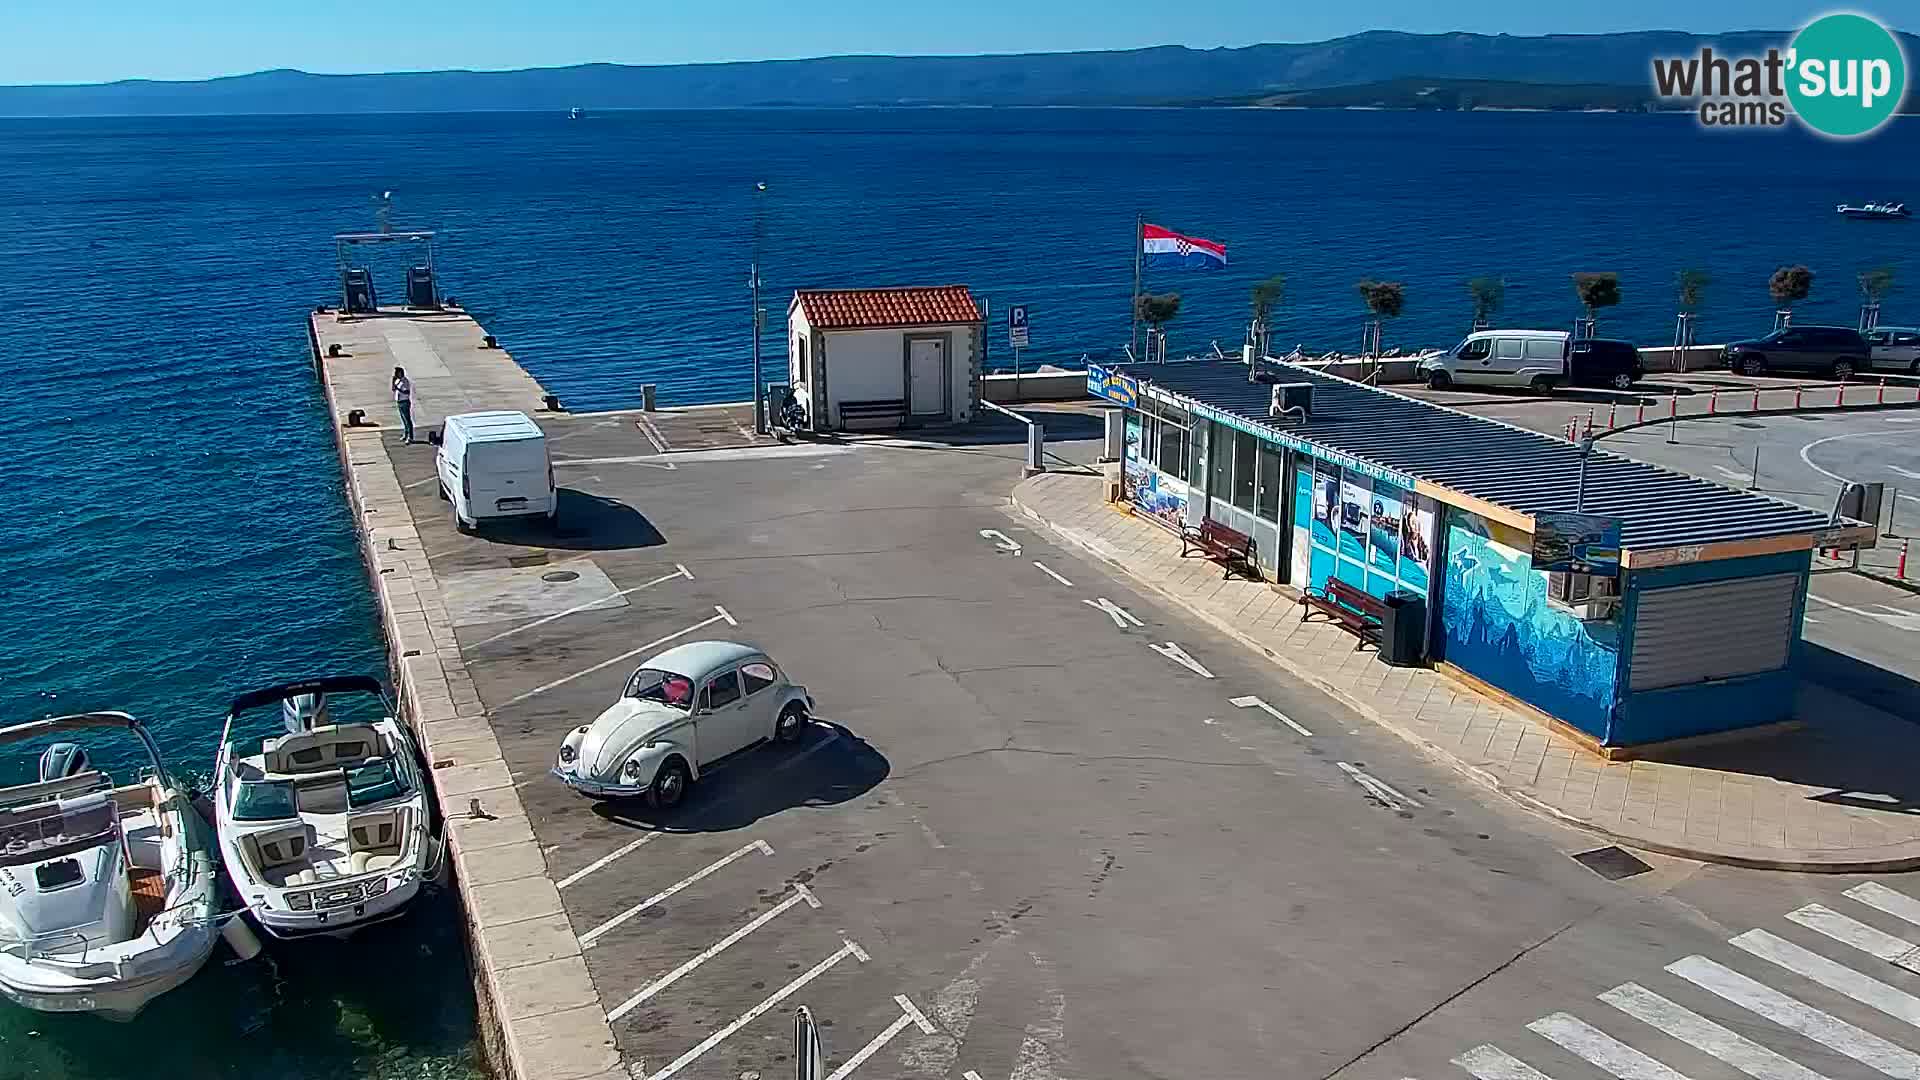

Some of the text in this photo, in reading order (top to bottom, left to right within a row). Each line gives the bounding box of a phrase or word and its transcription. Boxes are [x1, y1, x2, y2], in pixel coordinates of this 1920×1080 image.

[1014, 308, 1024, 325] P
[1271, 430, 1301, 450] POSTAJA
[1311, 444, 1325, 459] BUS
[1326, 448, 1356, 470] STATION
[1358, 460, 1383, 478] TICKET
[1383, 468, 1411, 488] OFFICE
